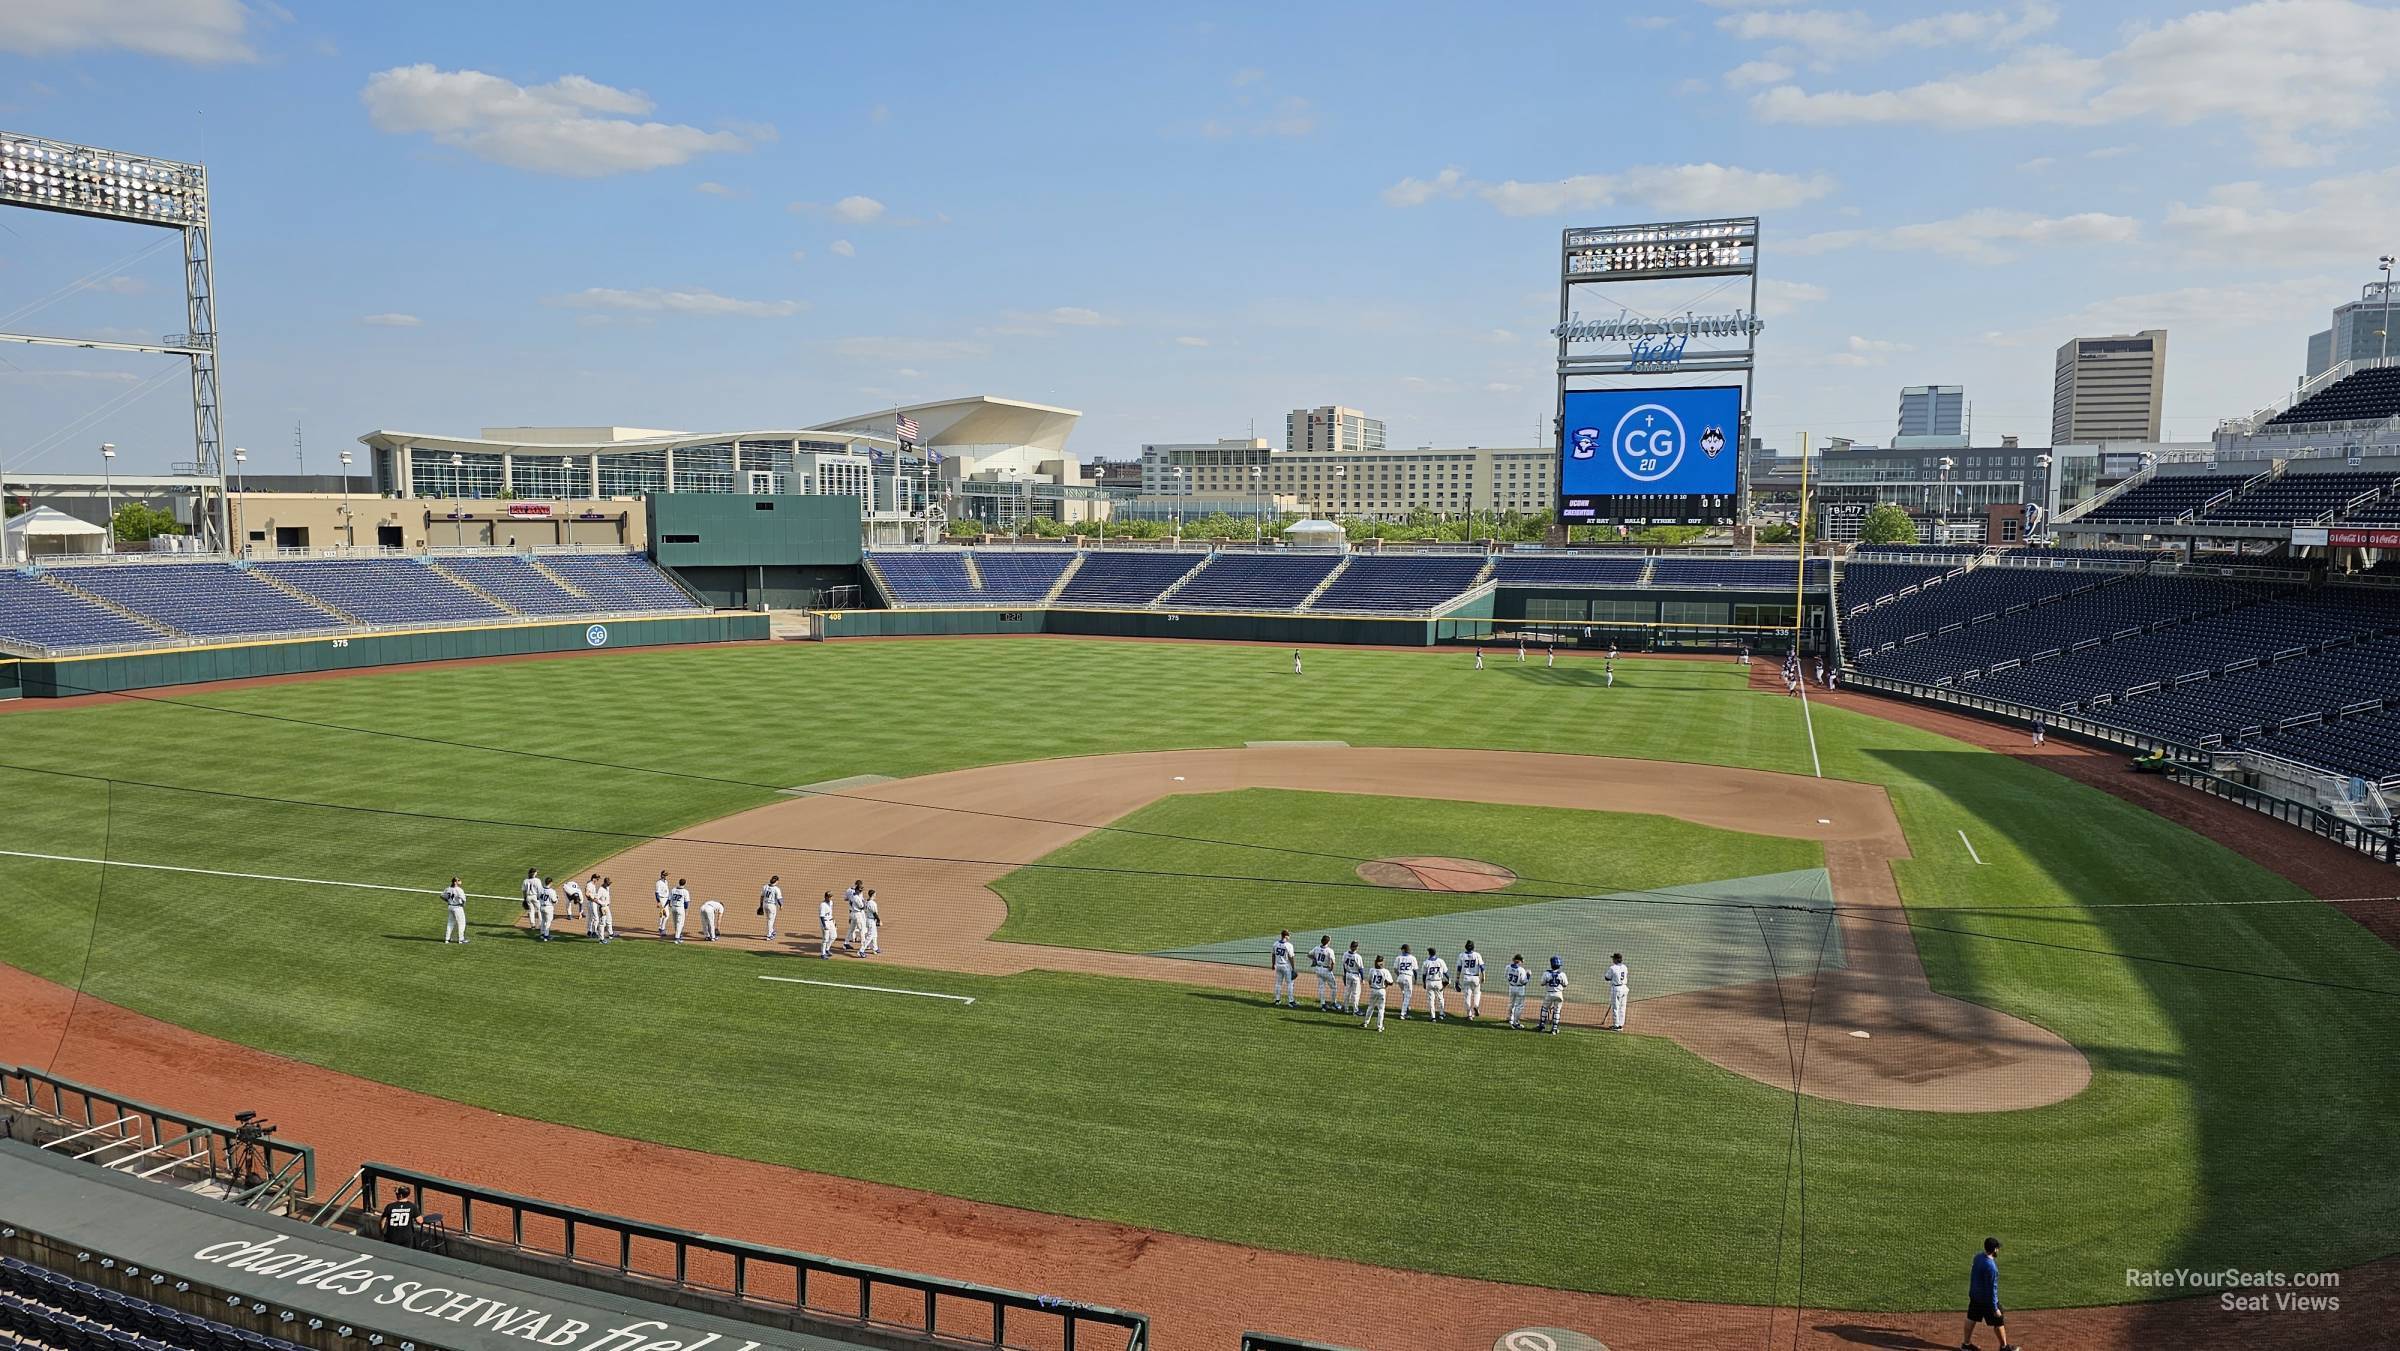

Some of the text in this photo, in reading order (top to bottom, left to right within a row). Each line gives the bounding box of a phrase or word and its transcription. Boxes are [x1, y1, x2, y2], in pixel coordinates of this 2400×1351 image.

[1554, 309, 1650, 338] charles
[1624, 334, 1687, 370] field
[1624, 429, 1673, 457] CG
[1639, 459, 1657, 471] 20
[1702, 499, 1708, 507] 0
[1715, 499, 1720, 507] 0
[590, 631, 604, 640] CG
[332, 640, 348, 648] 375
[1400, 962, 1412, 970] 22
[1372, 975, 1383, 984] 13
[390, 1212, 410, 1226] 20
[193, 1234, 394, 1295] charles
[373, 1281, 590, 1346] SCHWAB
